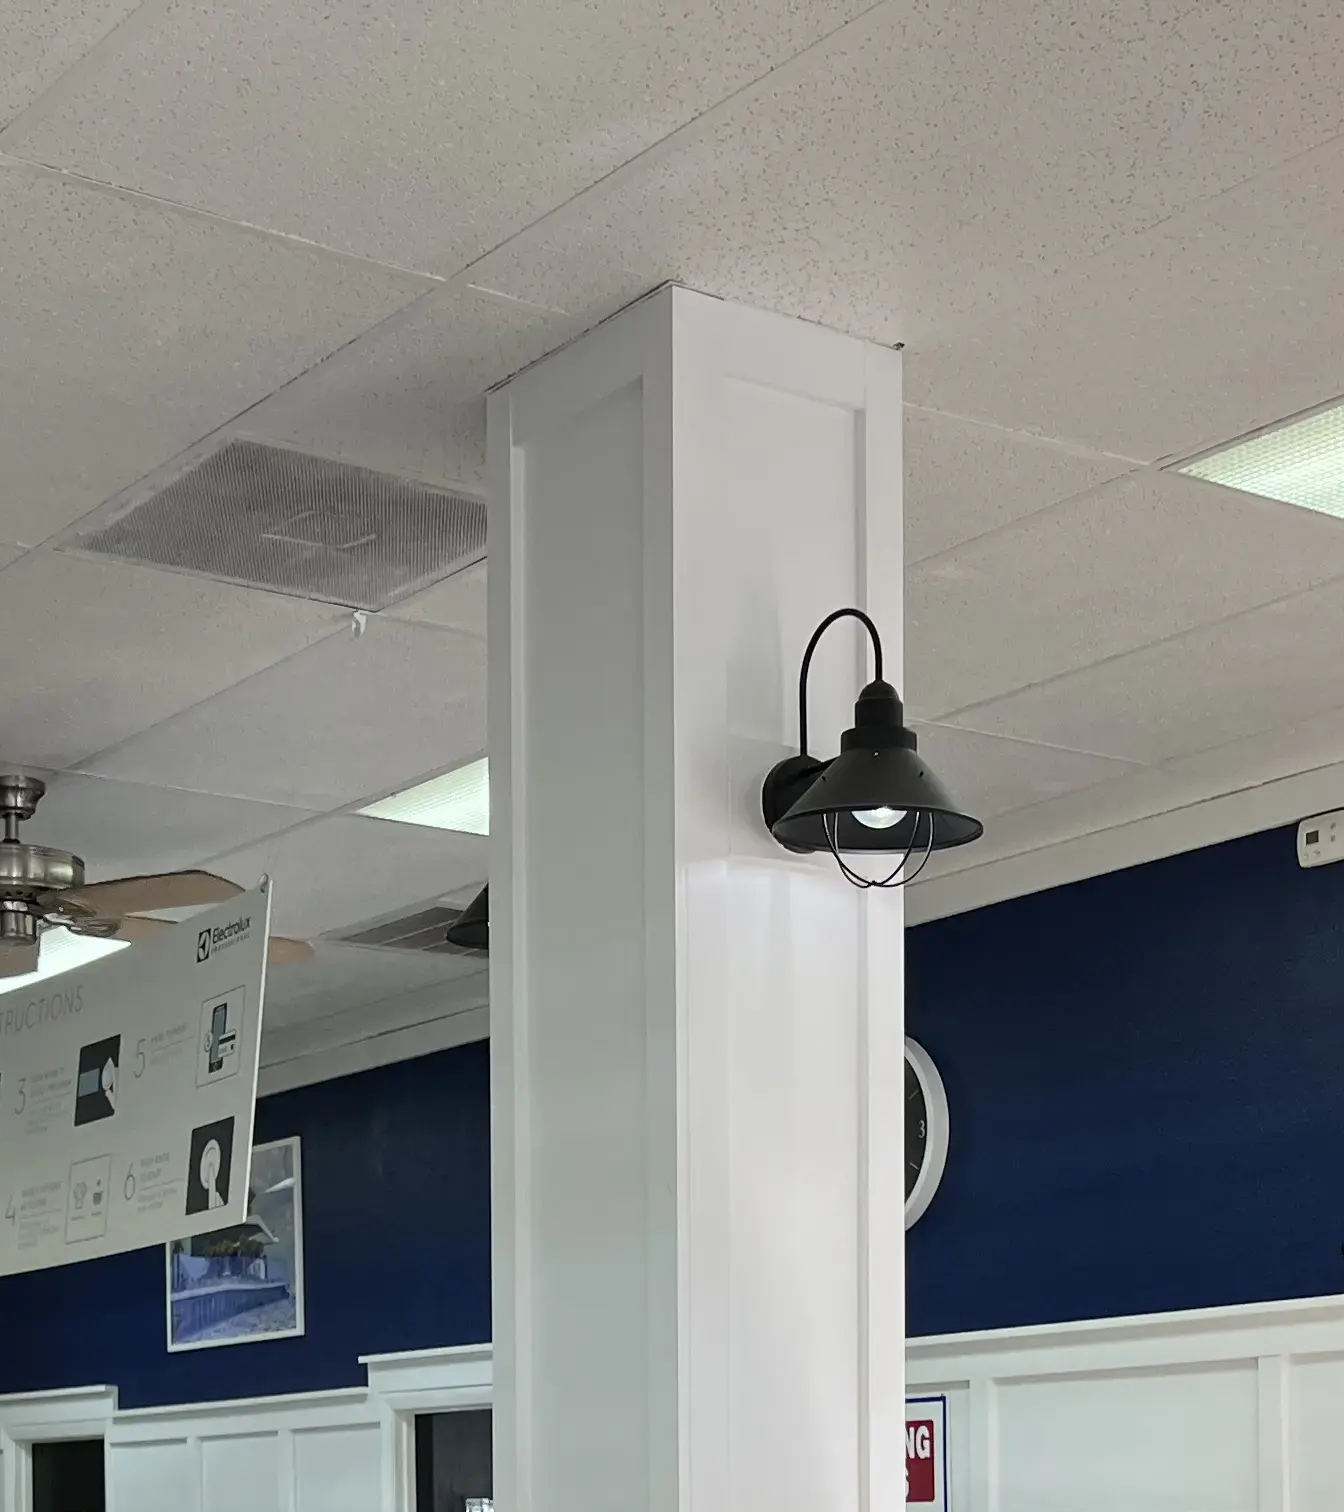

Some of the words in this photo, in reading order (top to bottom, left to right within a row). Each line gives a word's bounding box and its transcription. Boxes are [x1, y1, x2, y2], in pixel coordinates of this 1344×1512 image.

[212, 916, 252, 944] Electrolux
[133, 1038, 146, 1079] 5
[14, 1077, 27, 1115] 3
[918, 1120, 926, 1139] 3
[124, 1162, 136, 1201] 6
[5, 1191, 16, 1226] 4
